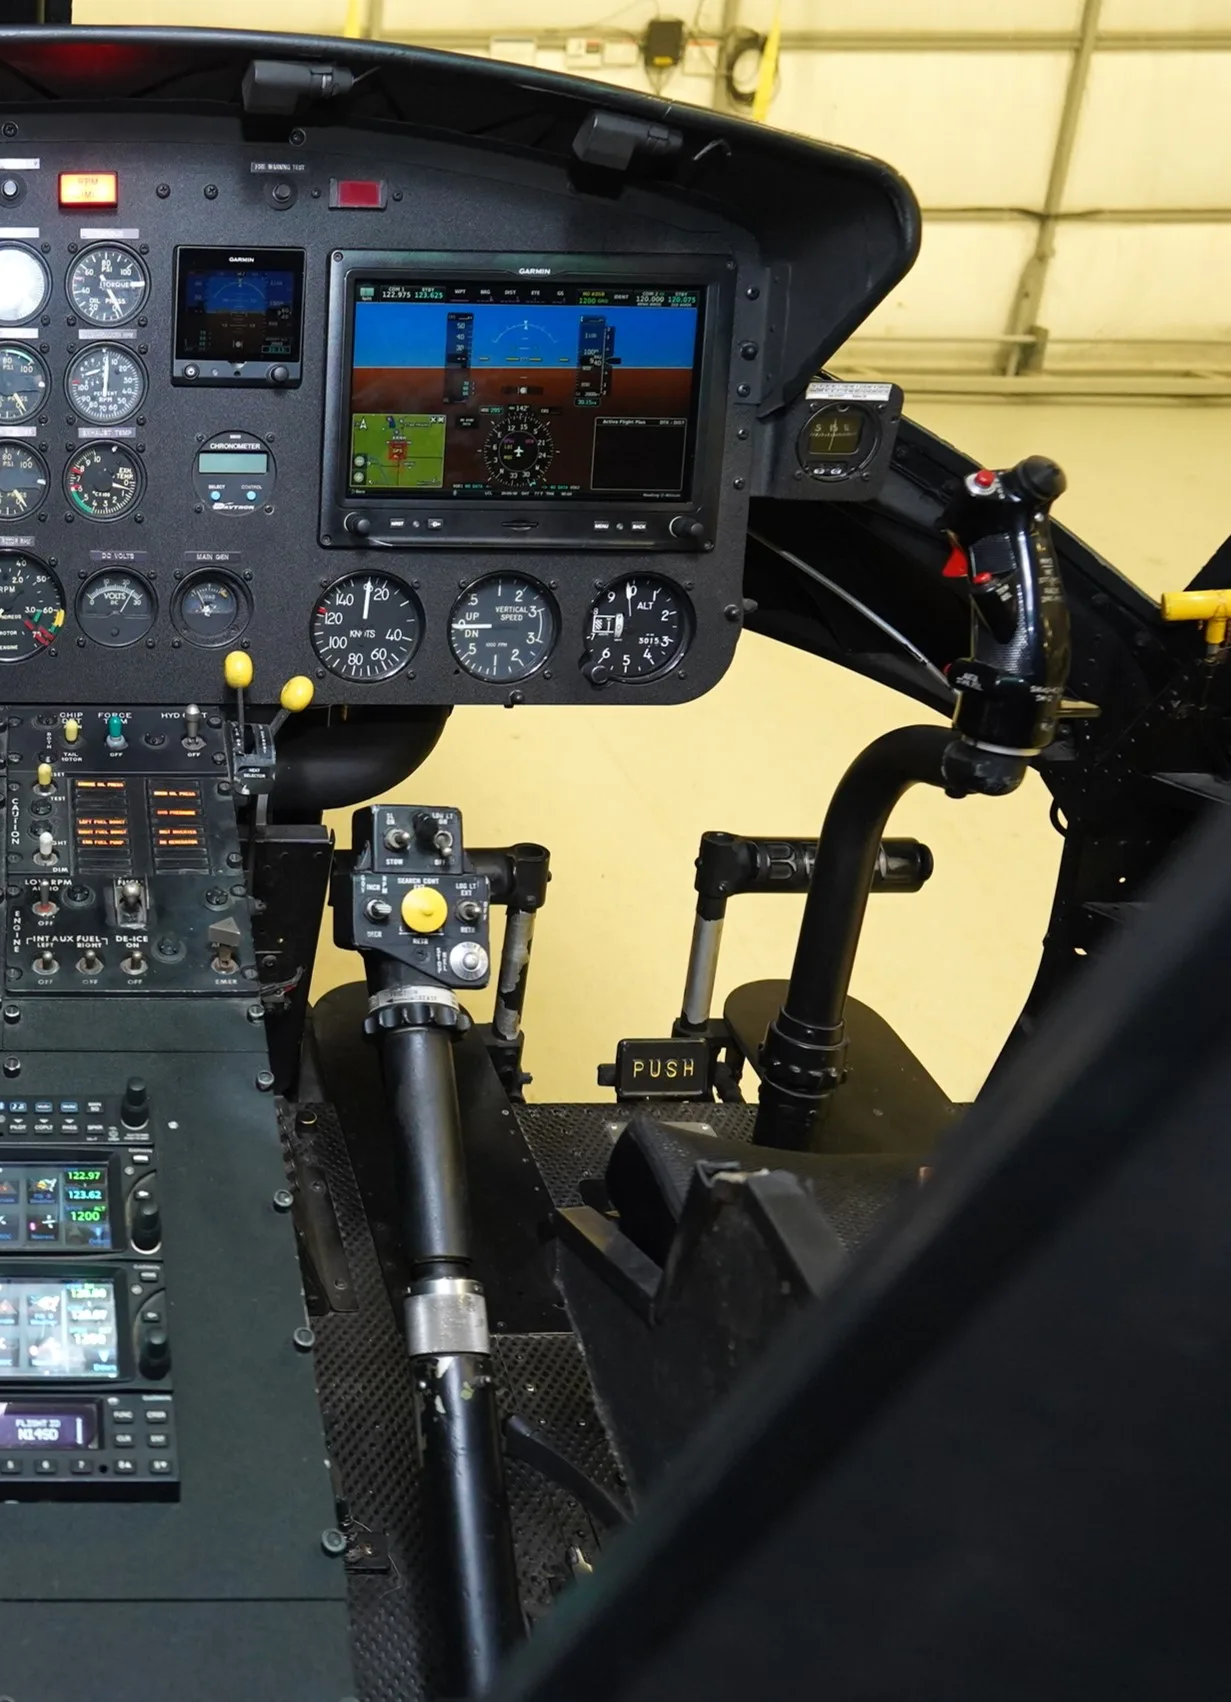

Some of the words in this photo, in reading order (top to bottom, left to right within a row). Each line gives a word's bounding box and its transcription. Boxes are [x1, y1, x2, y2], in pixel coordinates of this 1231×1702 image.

[636, 295, 665, 303] 120.000
[20, 365, 33, 373] 100
[210, 442, 261, 450] CHRONOMETER
[104, 592, 126, 600] VOLTS
[373, 588, 389, 601] 20
[335, 594, 354, 606] 140
[637, 602, 654, 610] ALT
[324, 612, 343, 624] 120
[465, 612, 480, 620] UP
[385, 629, 402, 641] 40
[464, 630, 479, 638] DN
[329, 636, 348, 649] 100
[638, 637, 659, 645] 3015
[370, 648, 387, 660] 60
[348, 653, 363, 665] 80
[11, 798, 20, 845] CAUTION
[13, 910, 21, 953] ENGINE
[632, 1059, 694, 1078] PUSH
[68, 1172, 101, 1180] 122.97
[68, 1191, 102, 1199] 123.62
[71, 1211, 100, 1221] 1200
[113, 1411, 133, 1419] FUNC
[146, 1411, 166, 1419] CRSR
[15, 1419, 47, 1428] FLIGHT
[18, 1428, 59, 1441] N14SD
